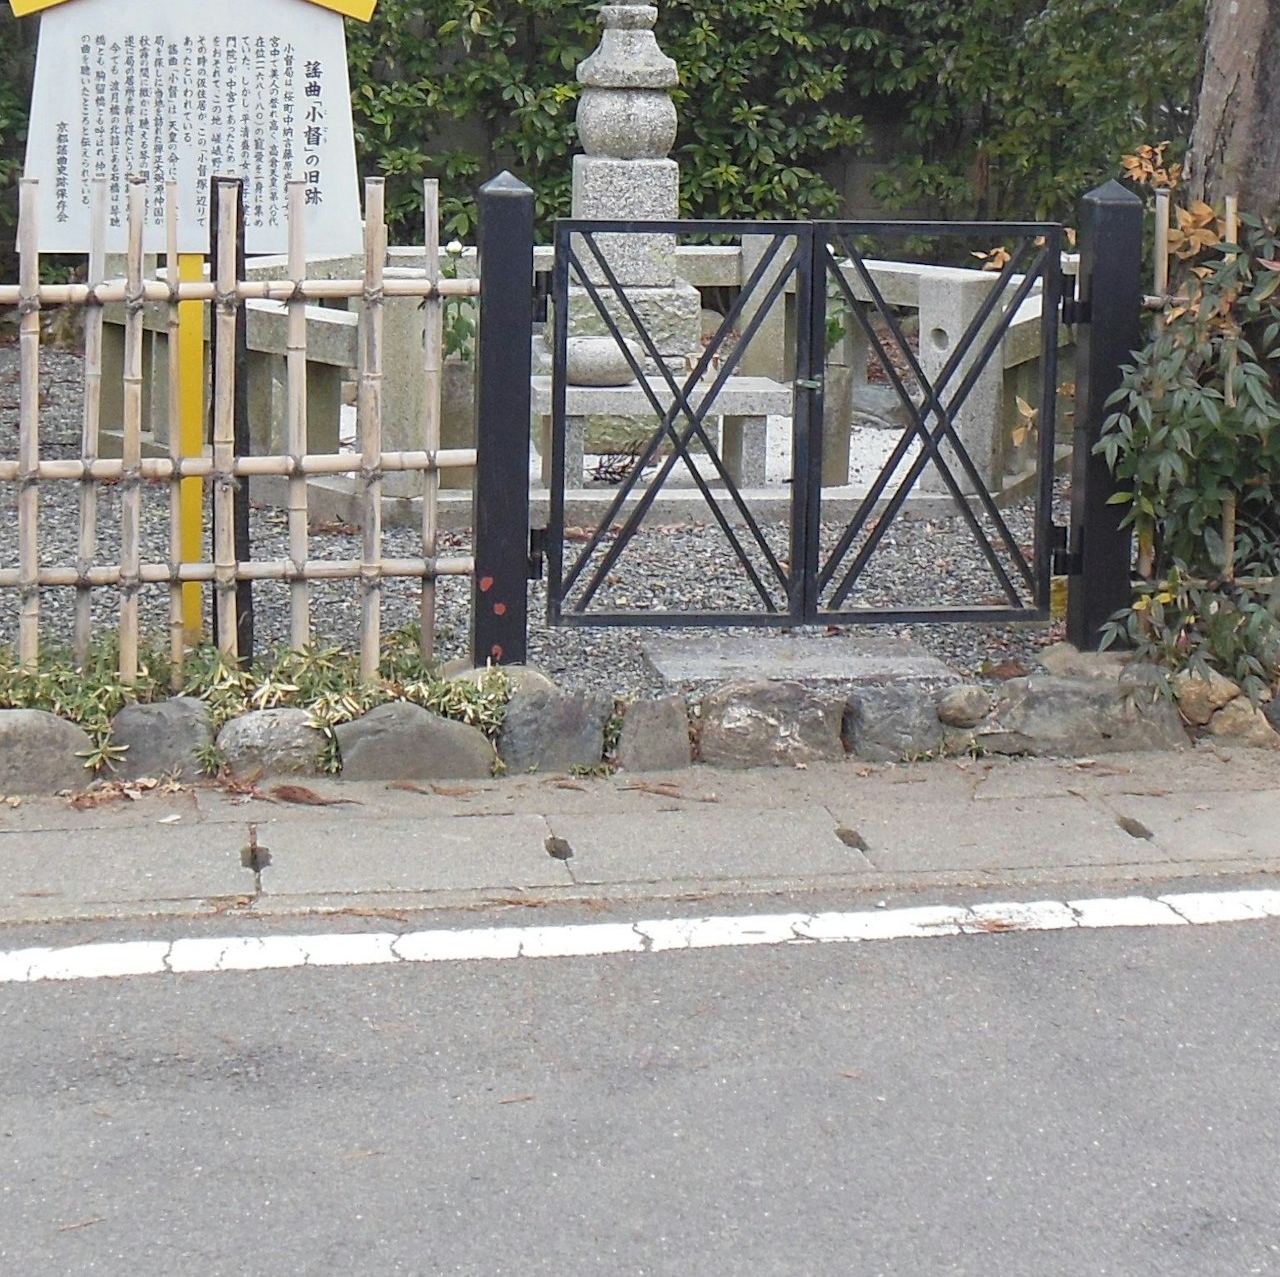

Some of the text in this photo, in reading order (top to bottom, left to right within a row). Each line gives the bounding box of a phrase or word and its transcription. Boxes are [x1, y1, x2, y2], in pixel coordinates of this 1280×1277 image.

[303, 60, 324, 205] 謡曲「小督」の旧跡
